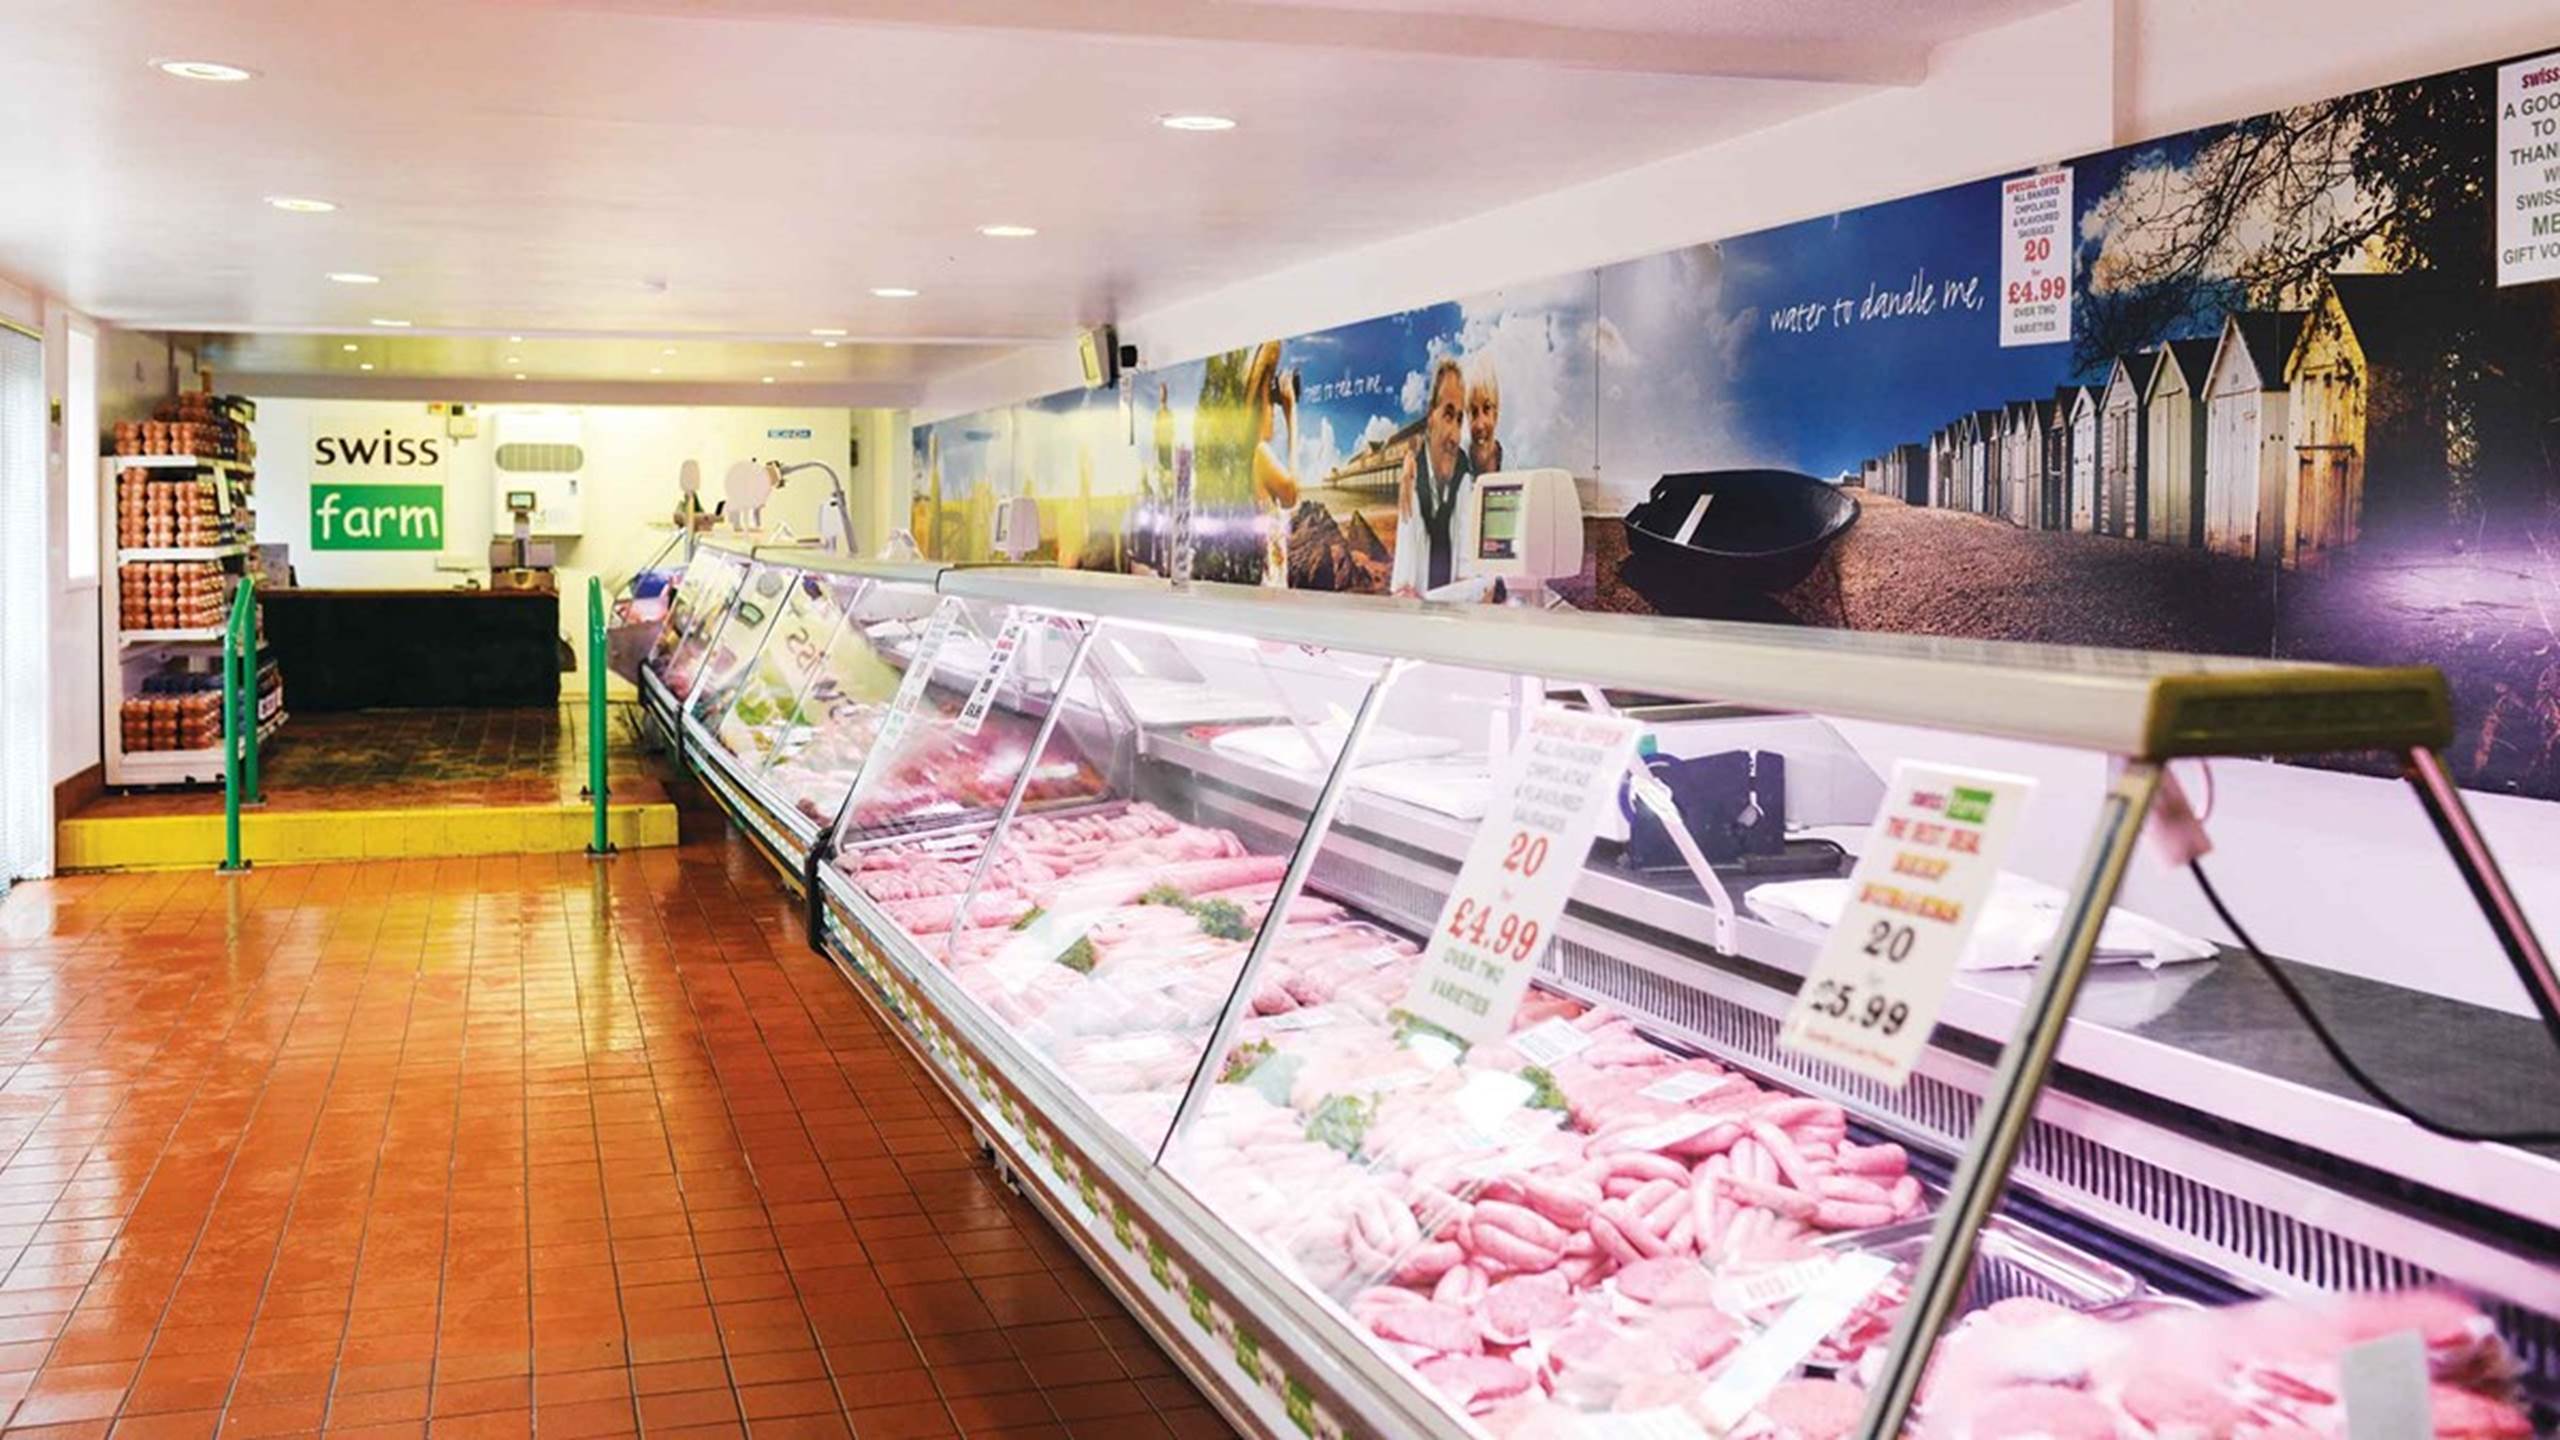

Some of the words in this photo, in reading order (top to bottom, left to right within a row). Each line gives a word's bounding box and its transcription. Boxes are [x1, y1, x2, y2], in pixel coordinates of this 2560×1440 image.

[2504, 103, 2516, 120] A
[2532, 118, 2556, 138] TO
[2024, 238, 2050, 262] 20
[2503, 245, 2535, 265] GIFT
[1770, 302, 1826, 333] water
[1833, 298, 1854, 328] to
[1860, 267, 1936, 321] dandle
[2008, 276, 2066, 304] £4.99
[315, 429, 439, 466] swiss
[315, 492, 439, 540] farm
[1503, 832, 1549, 877] 20
[1448, 898, 1539, 962] £4.99
[1863, 919, 1915, 963] 20
